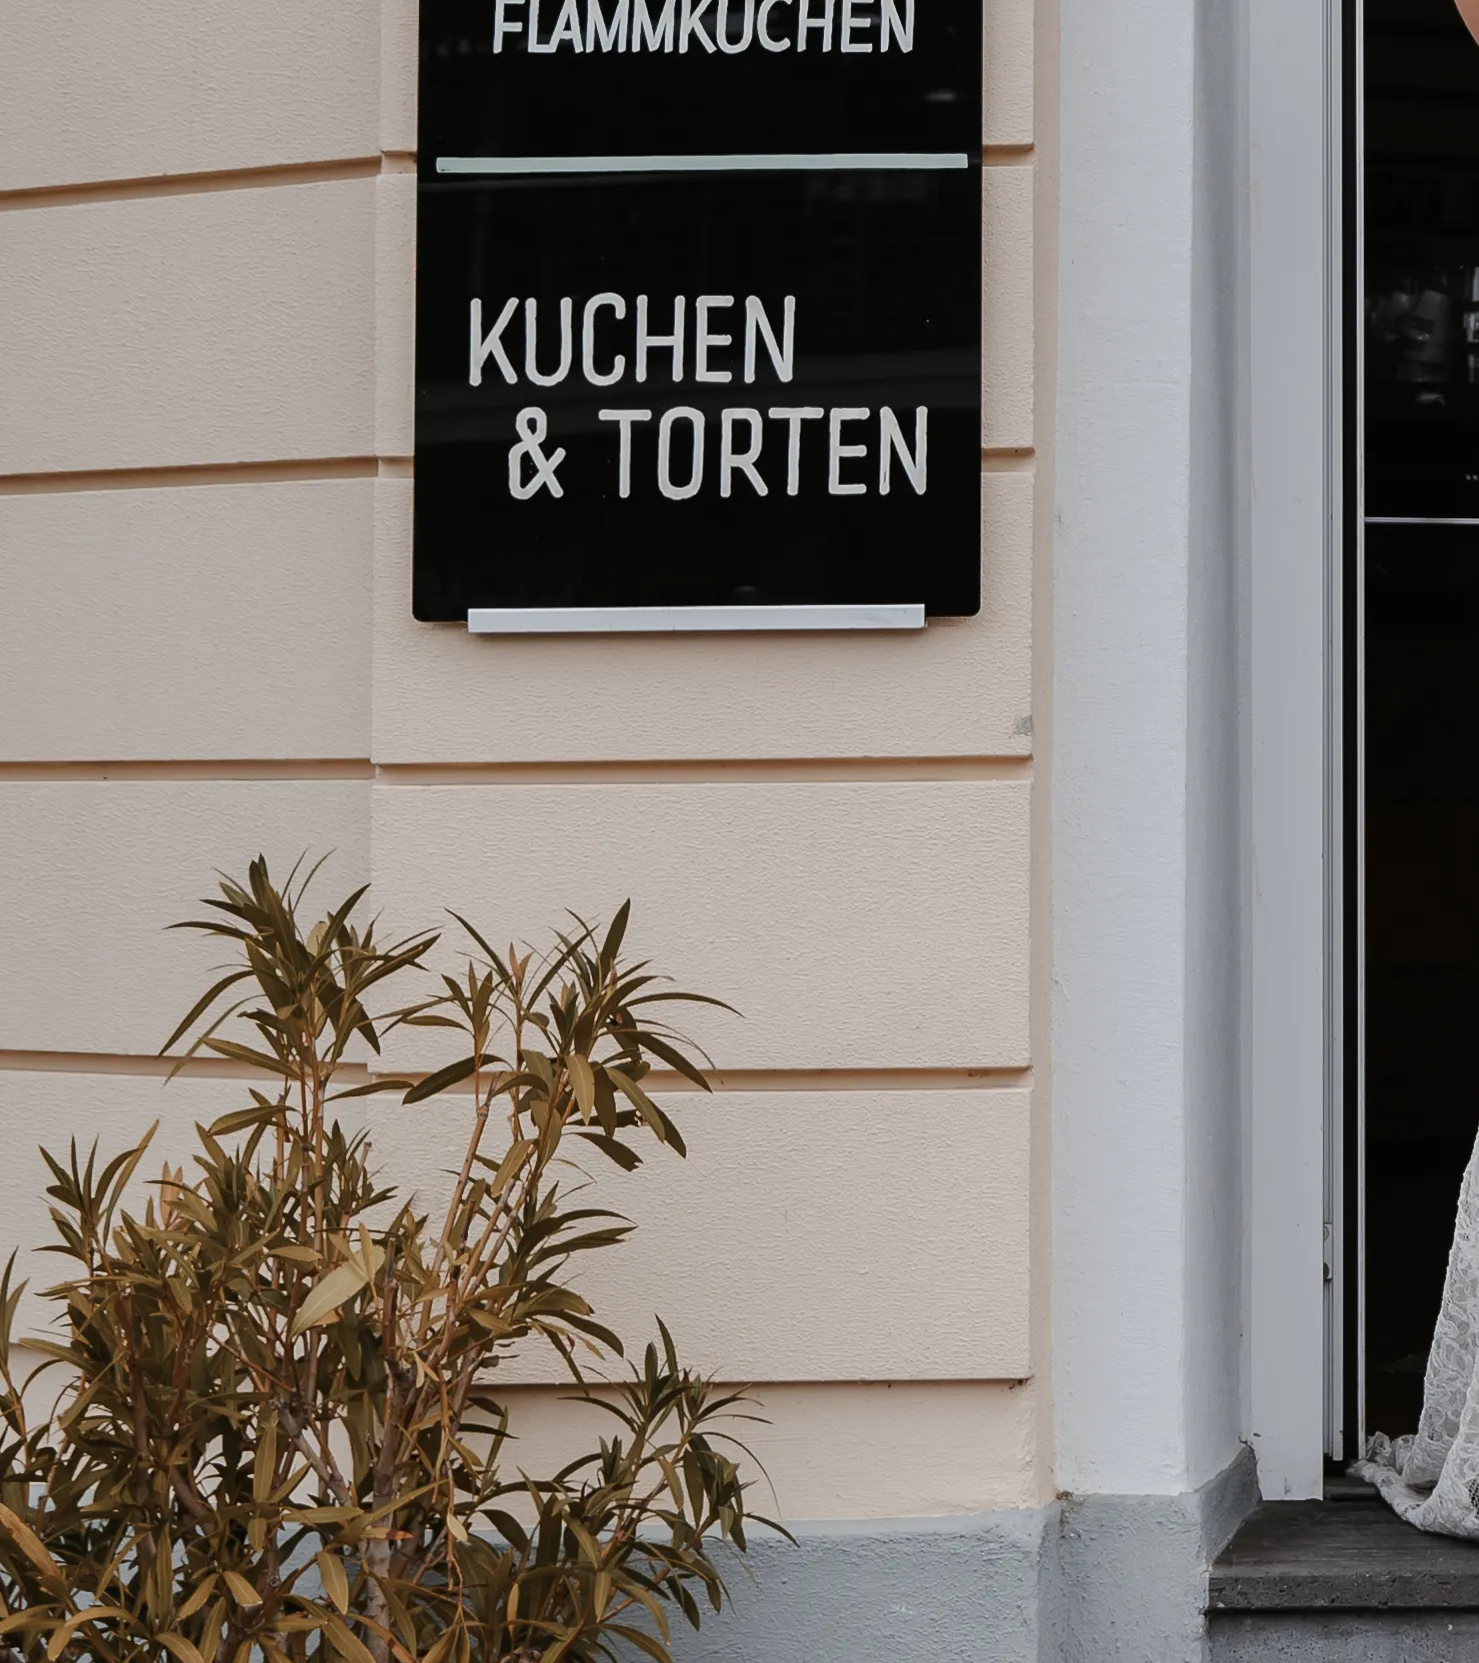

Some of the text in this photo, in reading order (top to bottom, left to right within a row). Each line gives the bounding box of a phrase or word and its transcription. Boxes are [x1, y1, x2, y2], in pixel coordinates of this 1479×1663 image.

[468, 292, 796, 387] KUCHEN
[507, 405, 928, 501] & TORTEN
